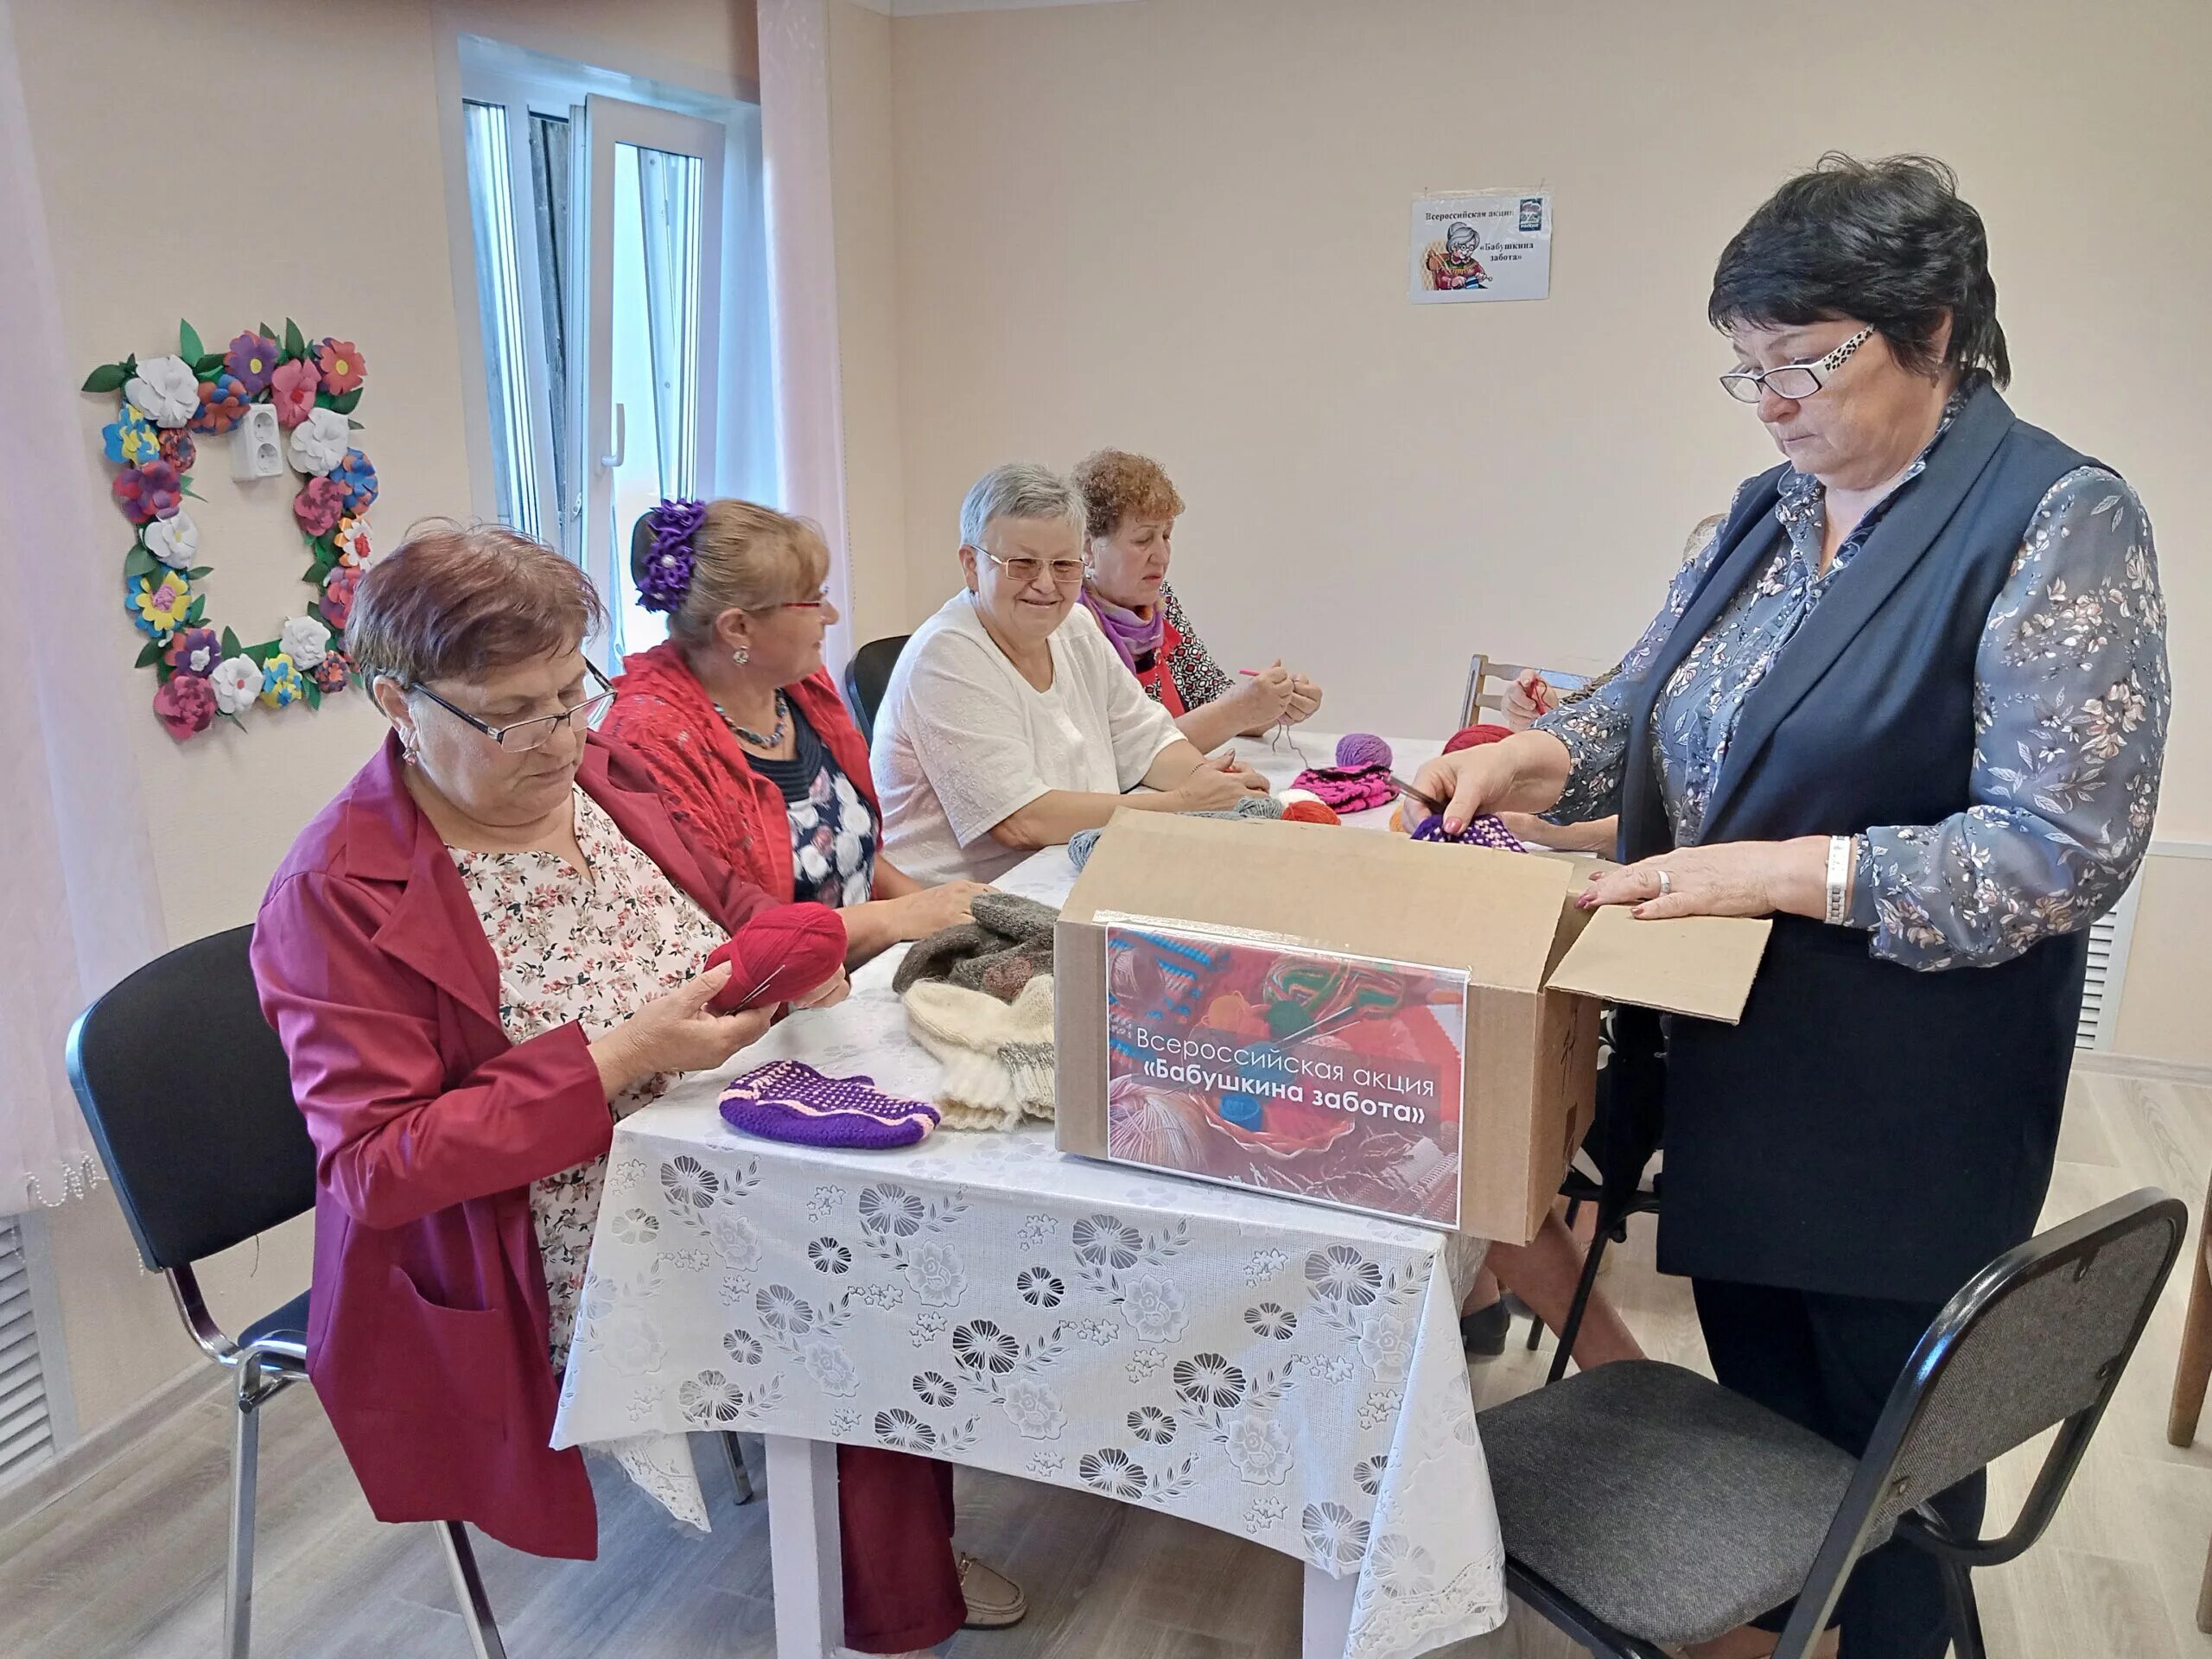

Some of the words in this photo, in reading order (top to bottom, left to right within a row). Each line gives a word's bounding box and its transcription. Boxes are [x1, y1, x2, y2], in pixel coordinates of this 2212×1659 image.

[1425, 211, 1487, 221] Всероссийская
[1479, 242, 1534, 252] «Бабушкина
[1136, 1027, 1344, 1082] Всероссийская
[1352, 1069, 1434, 1097] акция
[1143, 1058, 1304, 1103] «Бабушкина
[1312, 1090, 1426, 1122] забота»
